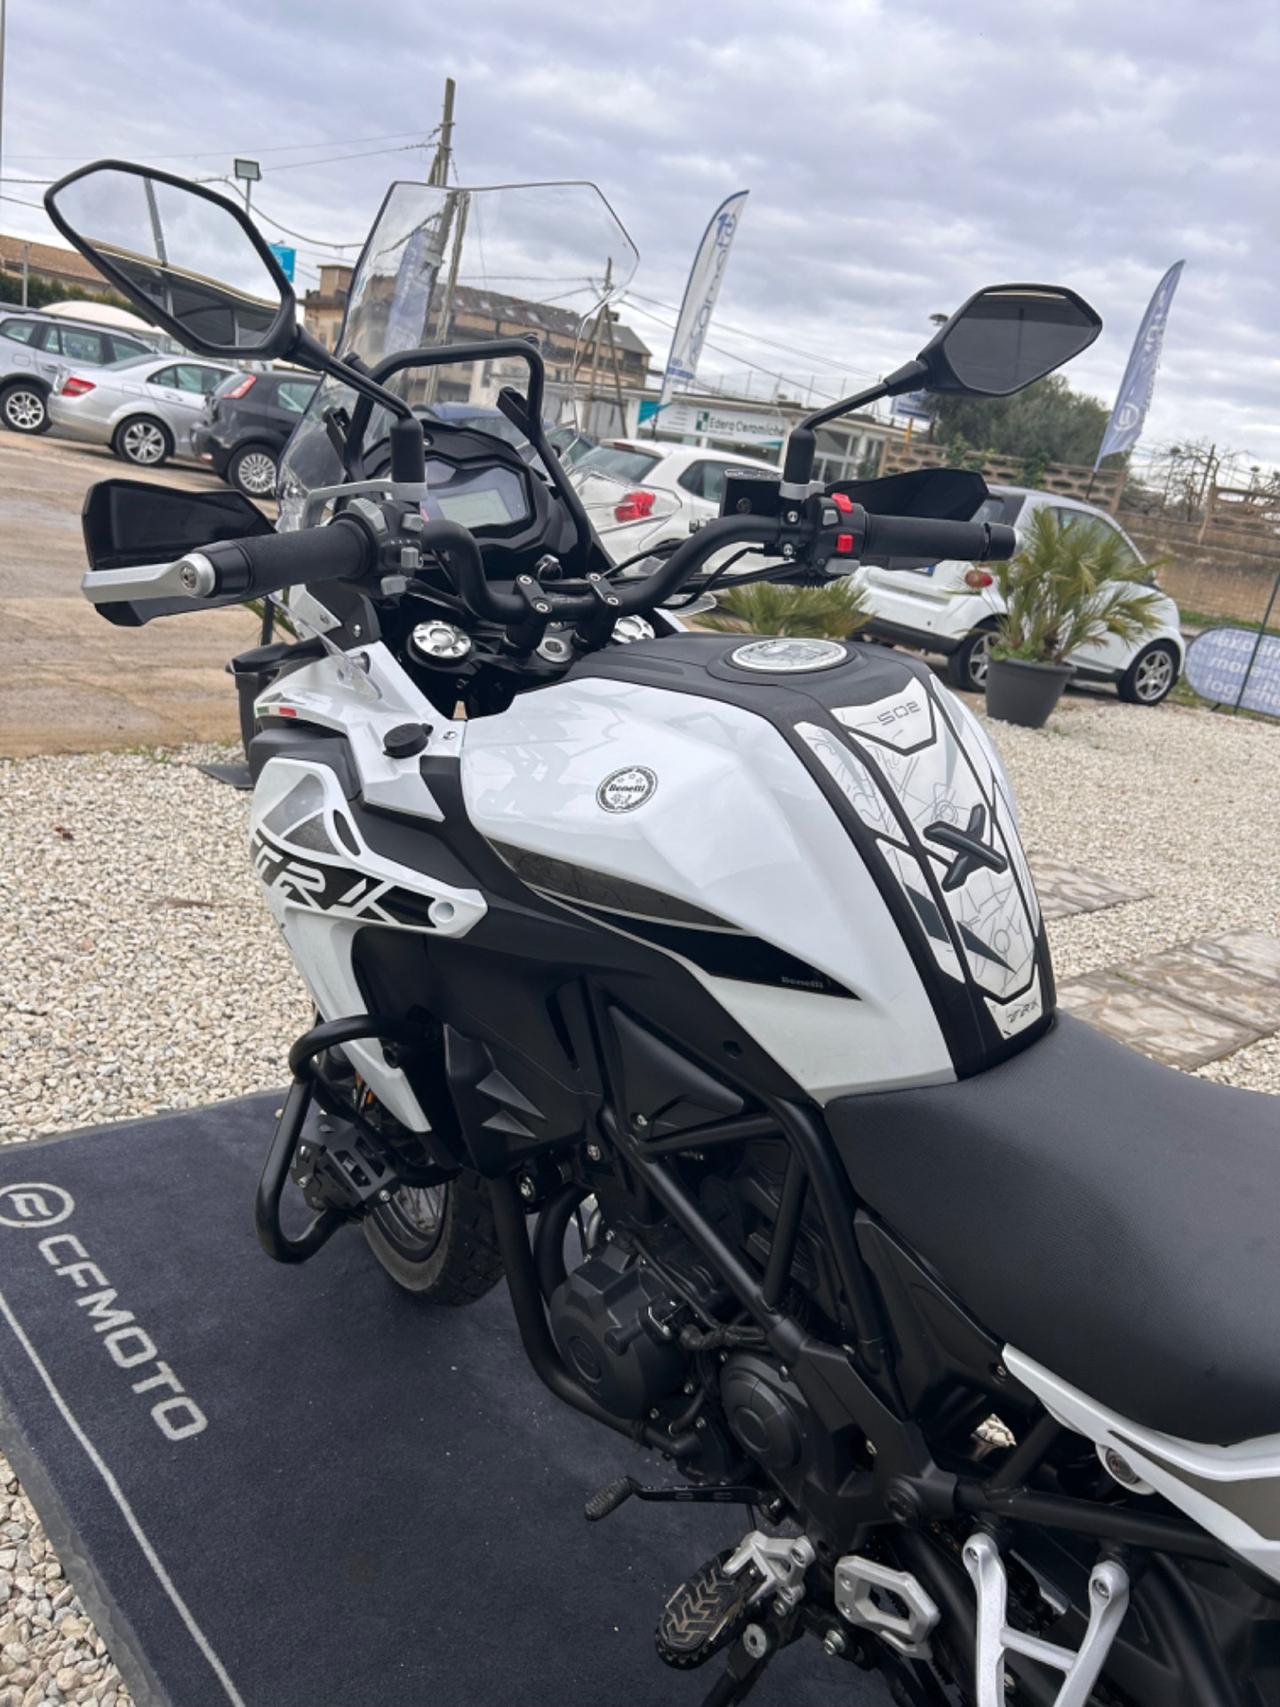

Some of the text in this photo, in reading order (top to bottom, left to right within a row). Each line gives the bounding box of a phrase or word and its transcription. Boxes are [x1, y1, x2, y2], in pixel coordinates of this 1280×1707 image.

[709, 417, 735, 431] Edera
[877, 701, 921, 726] 502
[608, 783, 646, 793] Benelli
[38, 1233, 208, 1441] CFMOTO
